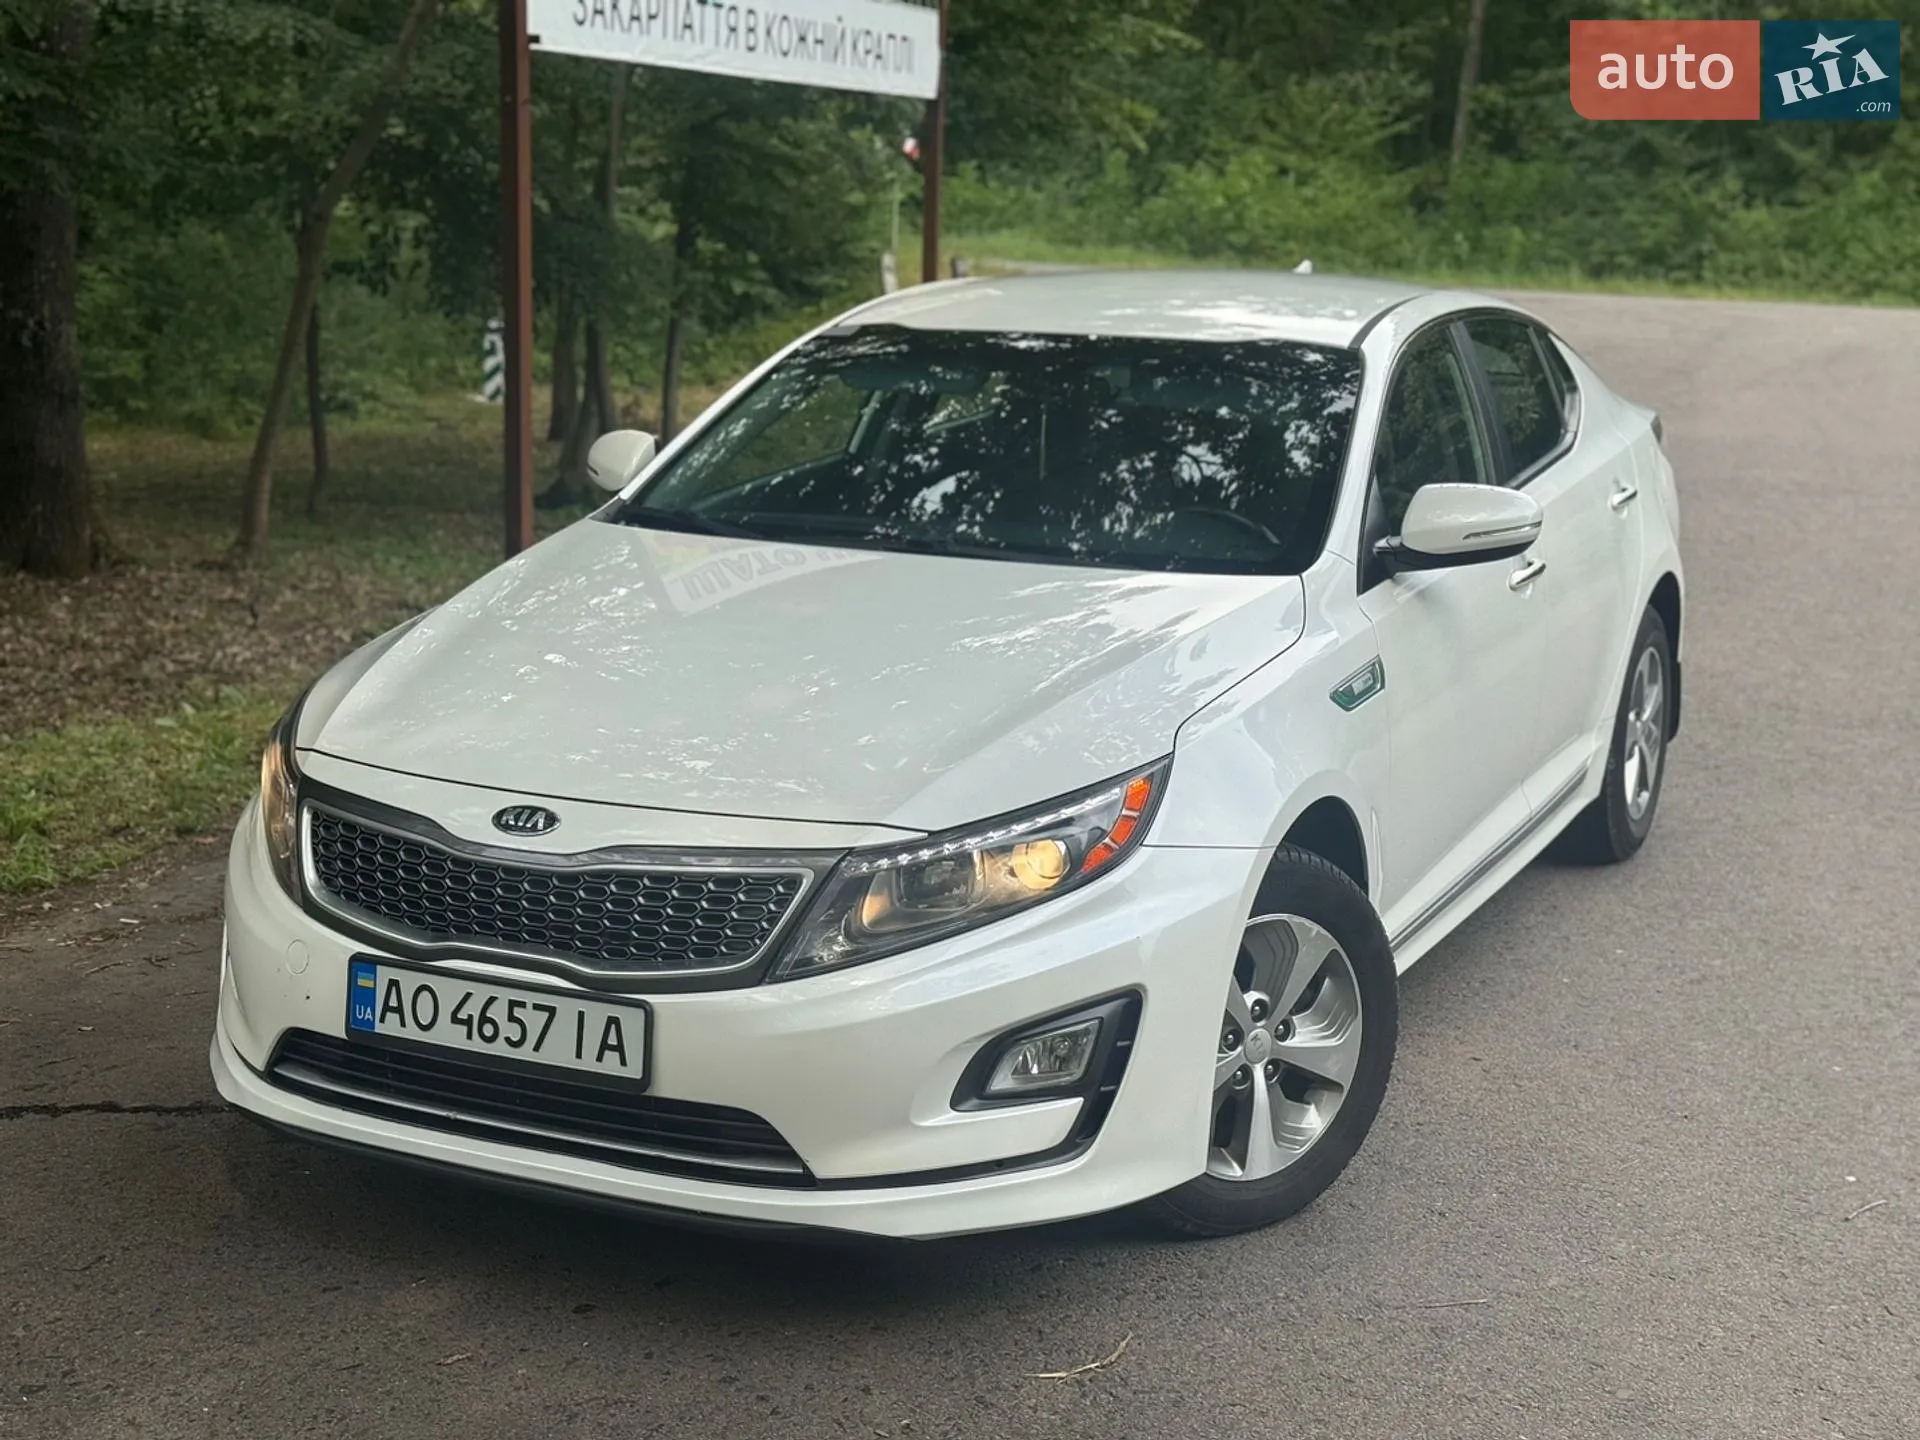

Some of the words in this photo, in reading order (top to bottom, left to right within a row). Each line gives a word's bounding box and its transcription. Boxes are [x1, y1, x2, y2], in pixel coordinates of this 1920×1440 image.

[500, 807, 546, 831] KIA
[355, 1004, 374, 1021] UA
[379, 978, 440, 1032] AO
[450, 991, 558, 1053] 4657
[574, 1009, 628, 1068] IA
